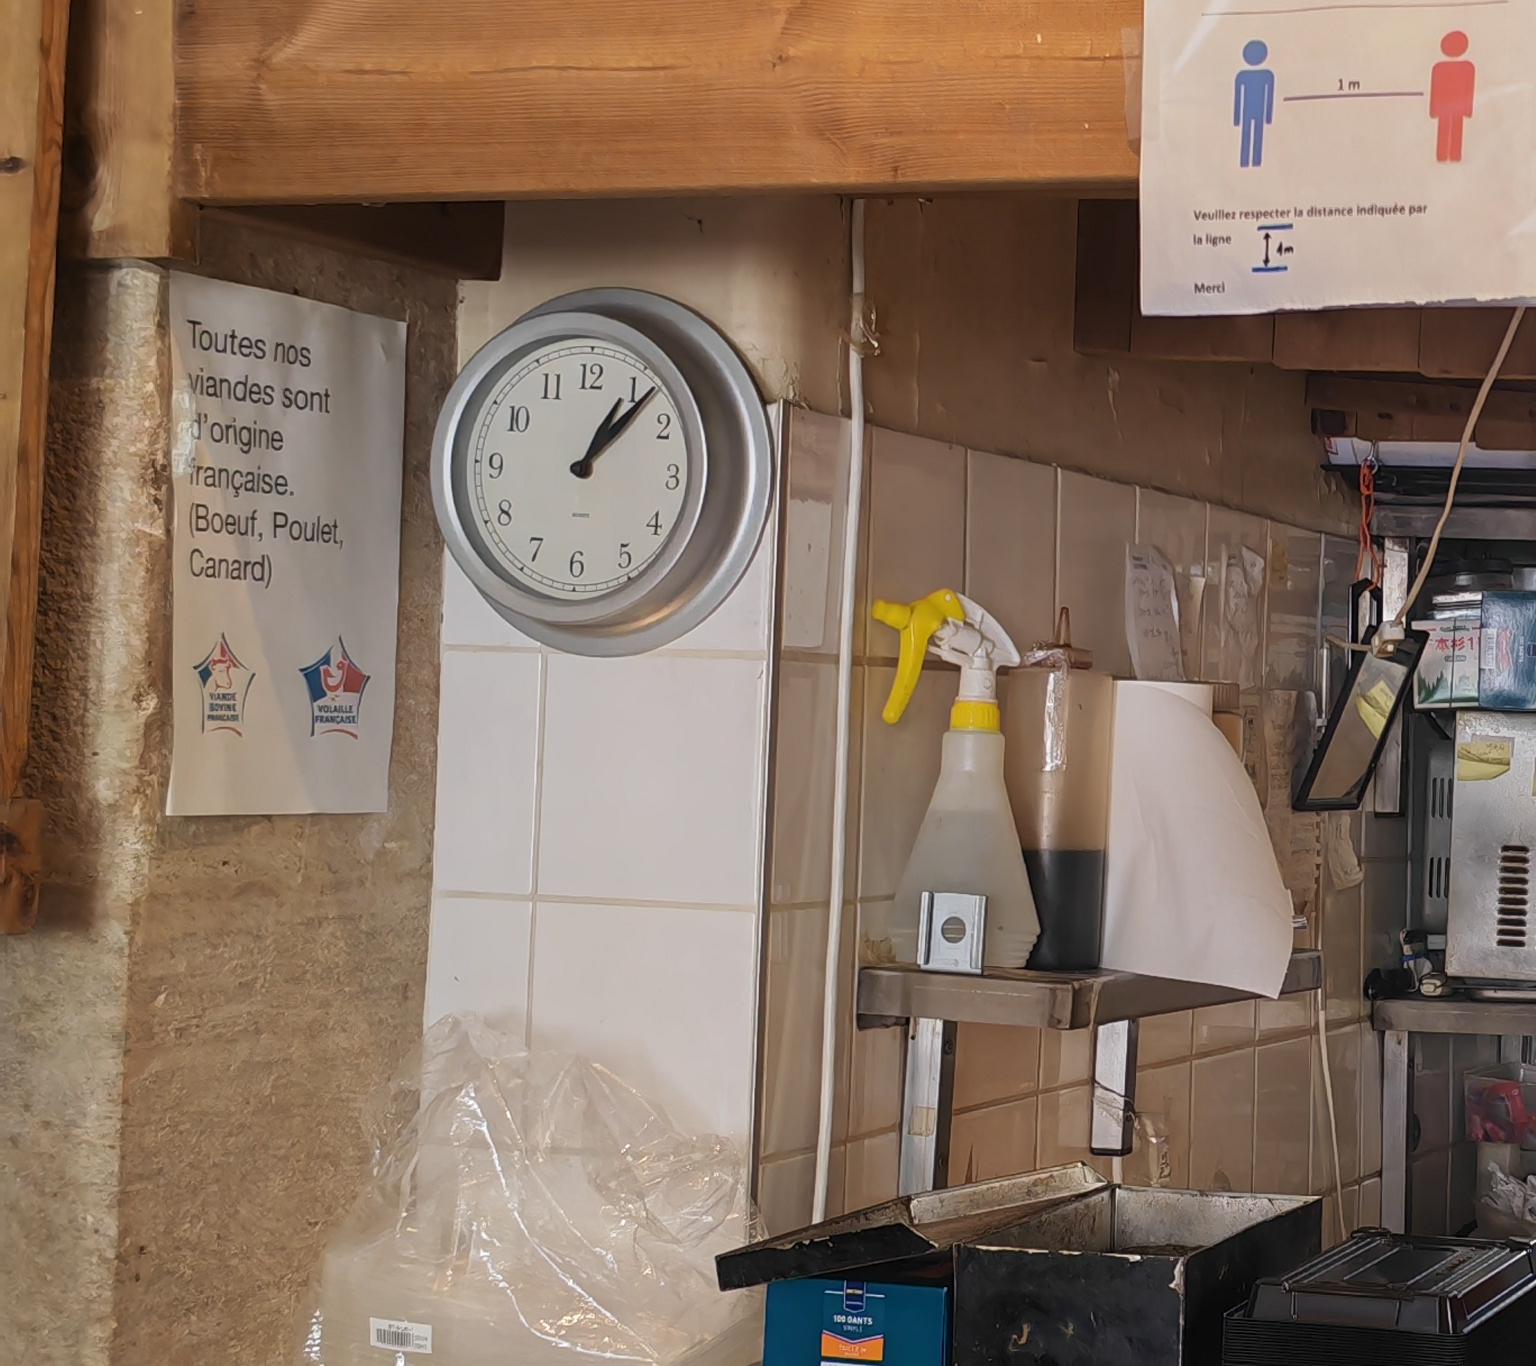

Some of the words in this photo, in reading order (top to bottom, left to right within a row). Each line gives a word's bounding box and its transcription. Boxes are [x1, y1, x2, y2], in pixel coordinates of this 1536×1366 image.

[1337, 78, 1345, 92] 1
[1348, 80, 1361, 92] m
[1193, 209, 1237, 222] Veuillez
[1238, 207, 1292, 222] respecter
[1293, 206, 1304, 219] la
[1306, 205, 1354, 218] distance
[1355, 203, 1406, 218] indiquée
[1408, 204, 1428, 217] par
[1193, 233, 1204, 245] la
[1205, 233, 1232, 249] ligne
[1194, 281, 1226, 295] Merci
[188, 319, 266, 361] Toutes
[274, 340, 312, 368] nos
[540, 373, 562, 401] 11
[578, 363, 605, 391] 12
[627, 377, 639, 403] 1
[189, 369, 276, 408] viandes
[281, 382, 331, 415] sont
[507, 406, 530, 433] 10
[656, 413, 671, 441] 2
[488, 452, 504, 480] 9
[665, 463, 680, 491] 3
[188, 502, 264, 541] (Boeuf,
[272, 510, 345, 551] Poulet,
[497, 499, 513, 527] 8
[646, 510, 663, 536] 4
[529, 537, 544, 562] 7
[617, 542, 632, 570] 5
[189, 548, 273, 588] Canard)
[569, 550, 585, 578] 6
[317, 702, 355, 717] VOLAILLE
